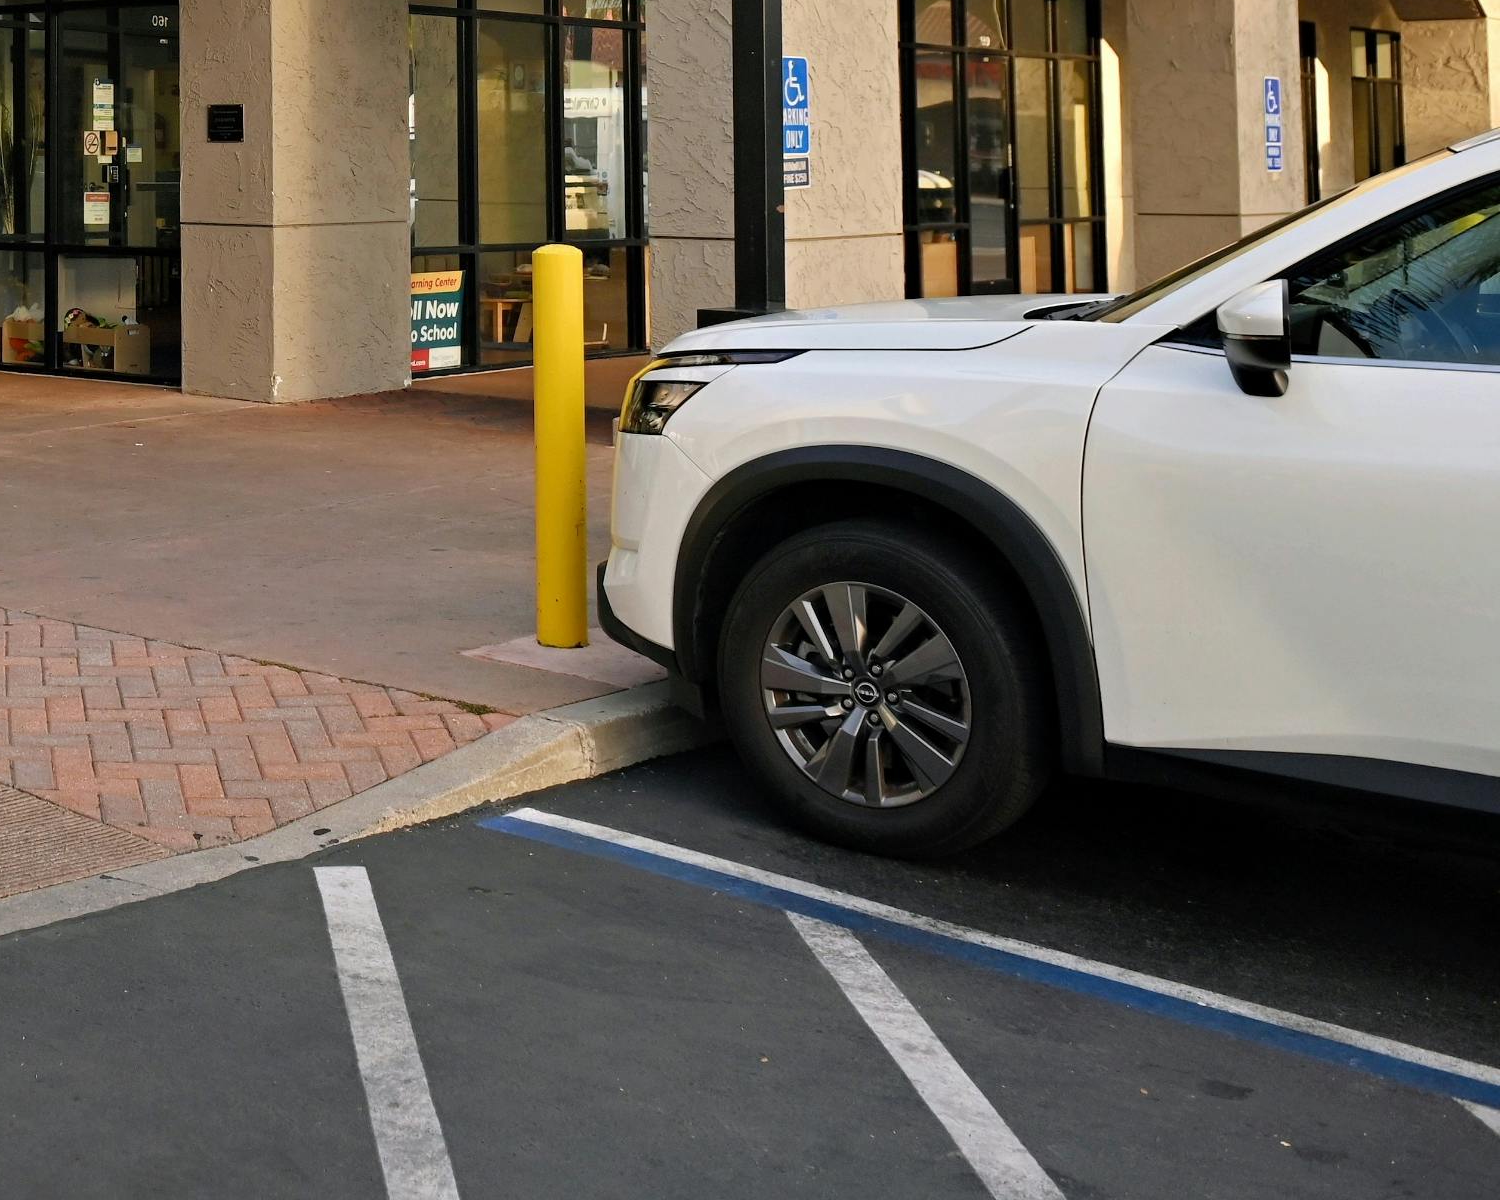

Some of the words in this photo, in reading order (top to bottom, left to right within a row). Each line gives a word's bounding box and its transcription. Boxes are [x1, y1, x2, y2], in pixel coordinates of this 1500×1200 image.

[783, 108, 808, 126] ARKING
[785, 130, 804, 149] ONLY
[411, 279, 433, 290] arning
[435, 277, 457, 287] Center
[425, 299, 459, 320] Now
[411, 329, 418, 343] o
[420, 322, 457, 342] School
